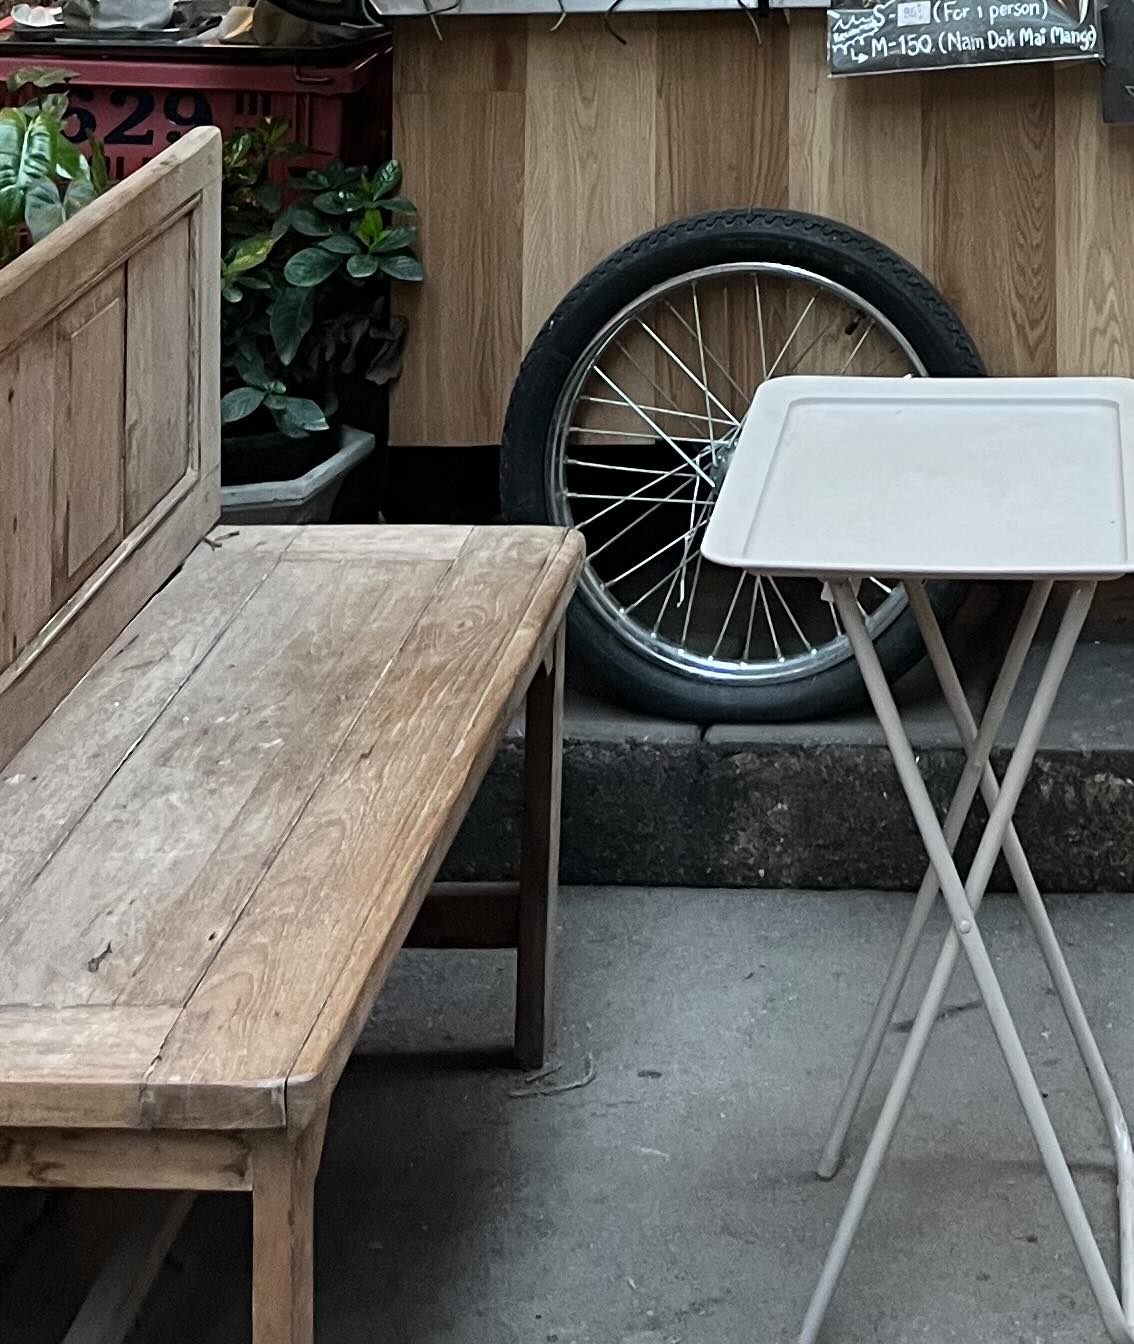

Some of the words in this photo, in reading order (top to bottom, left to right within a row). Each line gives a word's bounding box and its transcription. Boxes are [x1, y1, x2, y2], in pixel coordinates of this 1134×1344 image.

[933, 0, 968, 23] (For
[938, 31, 985, 54] (Nam
[988, 31, 1016, 48] Dok
[1019, 27, 1047, 47] Mai
[1050, 24, 1098, 51] Mango)
